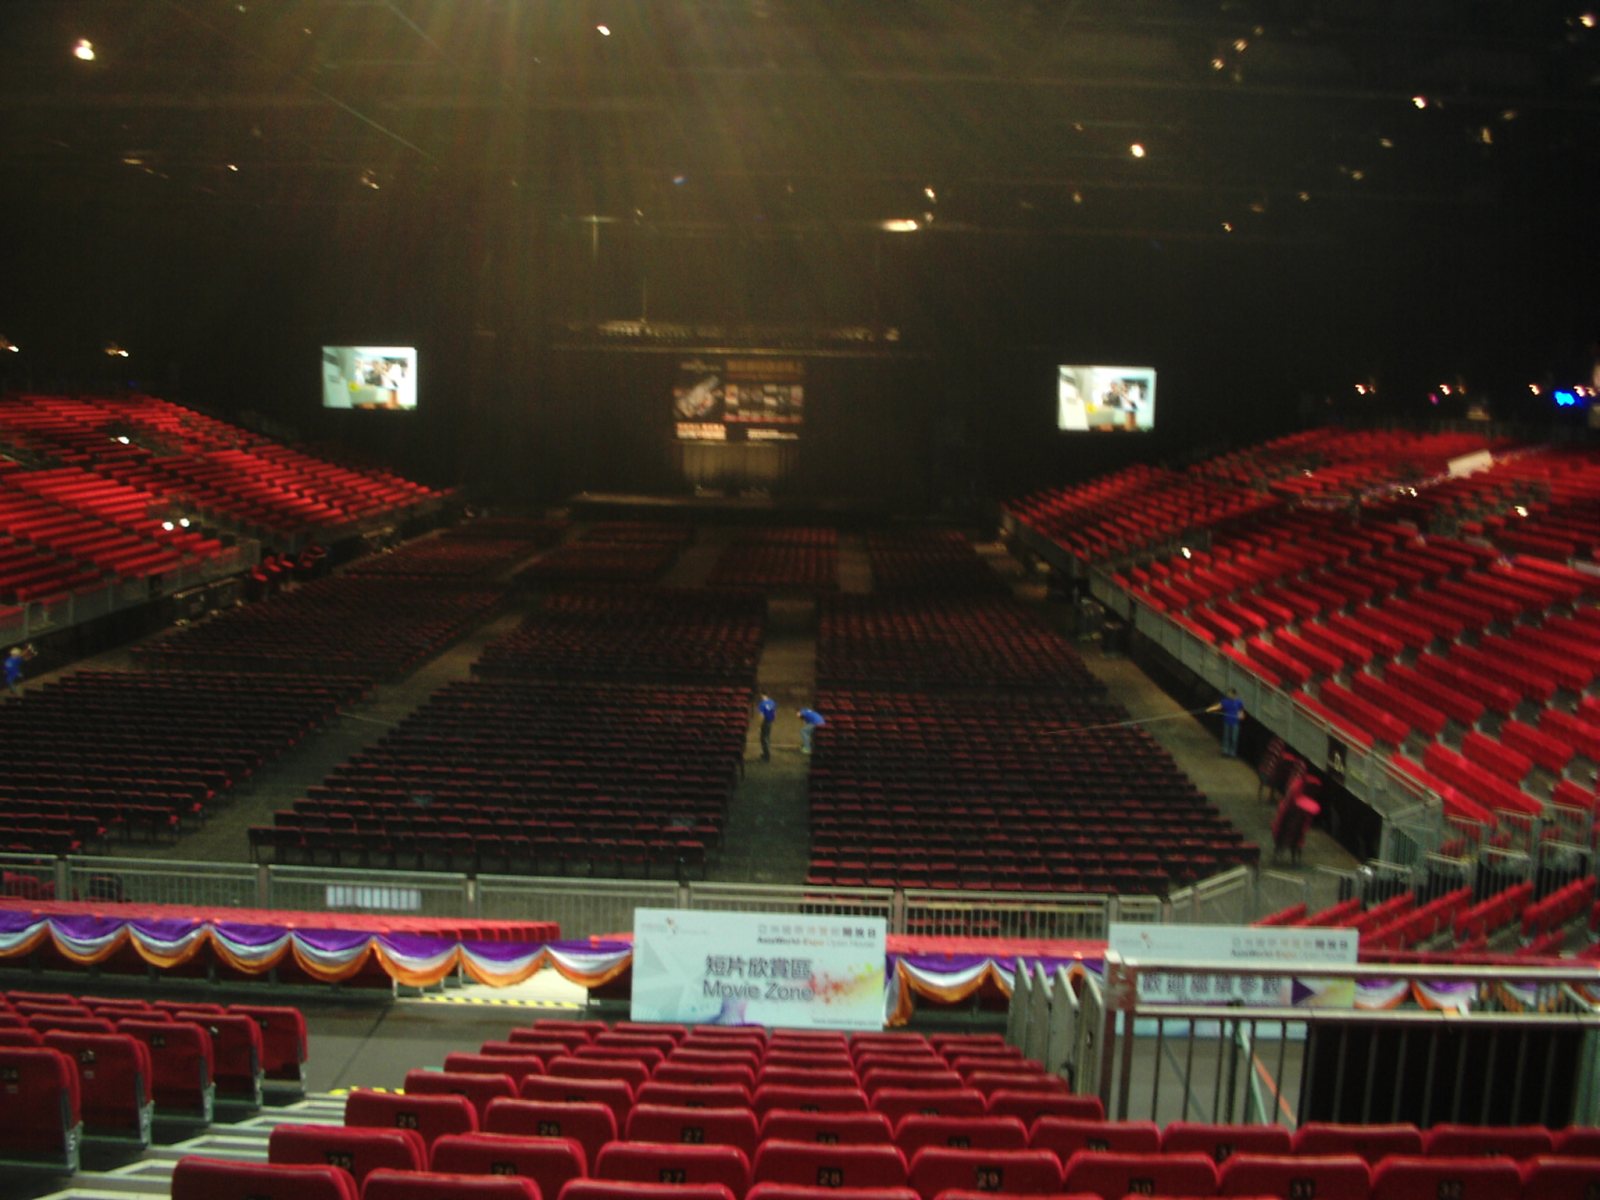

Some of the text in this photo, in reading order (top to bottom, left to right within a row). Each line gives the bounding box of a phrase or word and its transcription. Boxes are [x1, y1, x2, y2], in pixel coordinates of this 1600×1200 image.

[705, 955, 812, 979] 短片欣賞區
[703, 980, 816, 1001] Movie Zone
